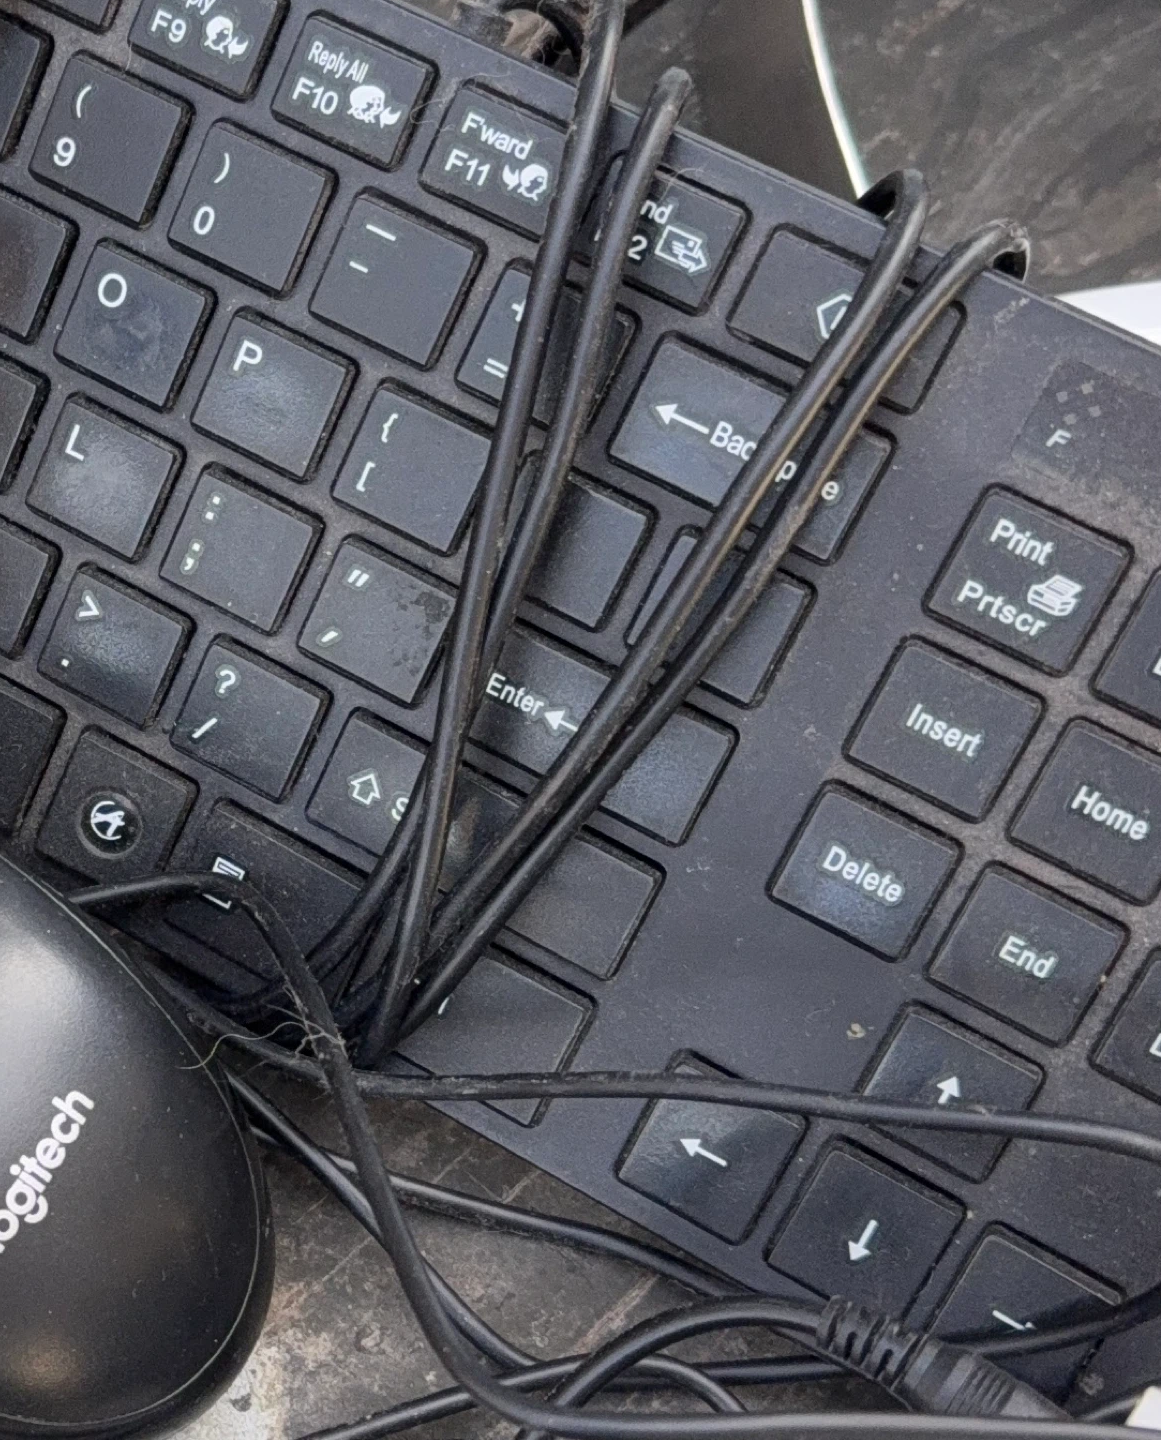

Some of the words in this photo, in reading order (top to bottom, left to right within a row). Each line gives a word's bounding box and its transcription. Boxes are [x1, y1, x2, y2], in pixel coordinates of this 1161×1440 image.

[152, 10, 186, 42] F9
[308, 41, 351, 78] Reply
[341, 59, 368, 83] All
[76, 85, 91, 118] (
[293, 77, 338, 114] F10
[54, 137, 76, 166] 9
[445, 149, 490, 185] F11
[214, 153, 230, 183] )
[194, 206, 214, 235] 0
[640, 200, 673, 224] nd
[98, 273, 127, 307] O
[233, 340, 262, 371] P
[65, 424, 84, 461] L
[381, 414, 398, 443] {
[1046, 429, 1071, 446] F
[356, 462, 375, 492] [
[206, 496, 220, 520] :
[184, 543, 200, 570] ;
[991, 519, 1053, 565] Print
[79, 595, 99, 617] >
[958, 580, 1049, 635] Prtscr
[219, 669, 236, 693] ?
[486, 673, 548, 719] Enter
[192, 718, 217, 738] /
[907, 704, 980, 756] Insert
[1072, 786, 1147, 839] Home
[823, 846, 901, 901] Delete
[1000, 936, 1055, 978] End
